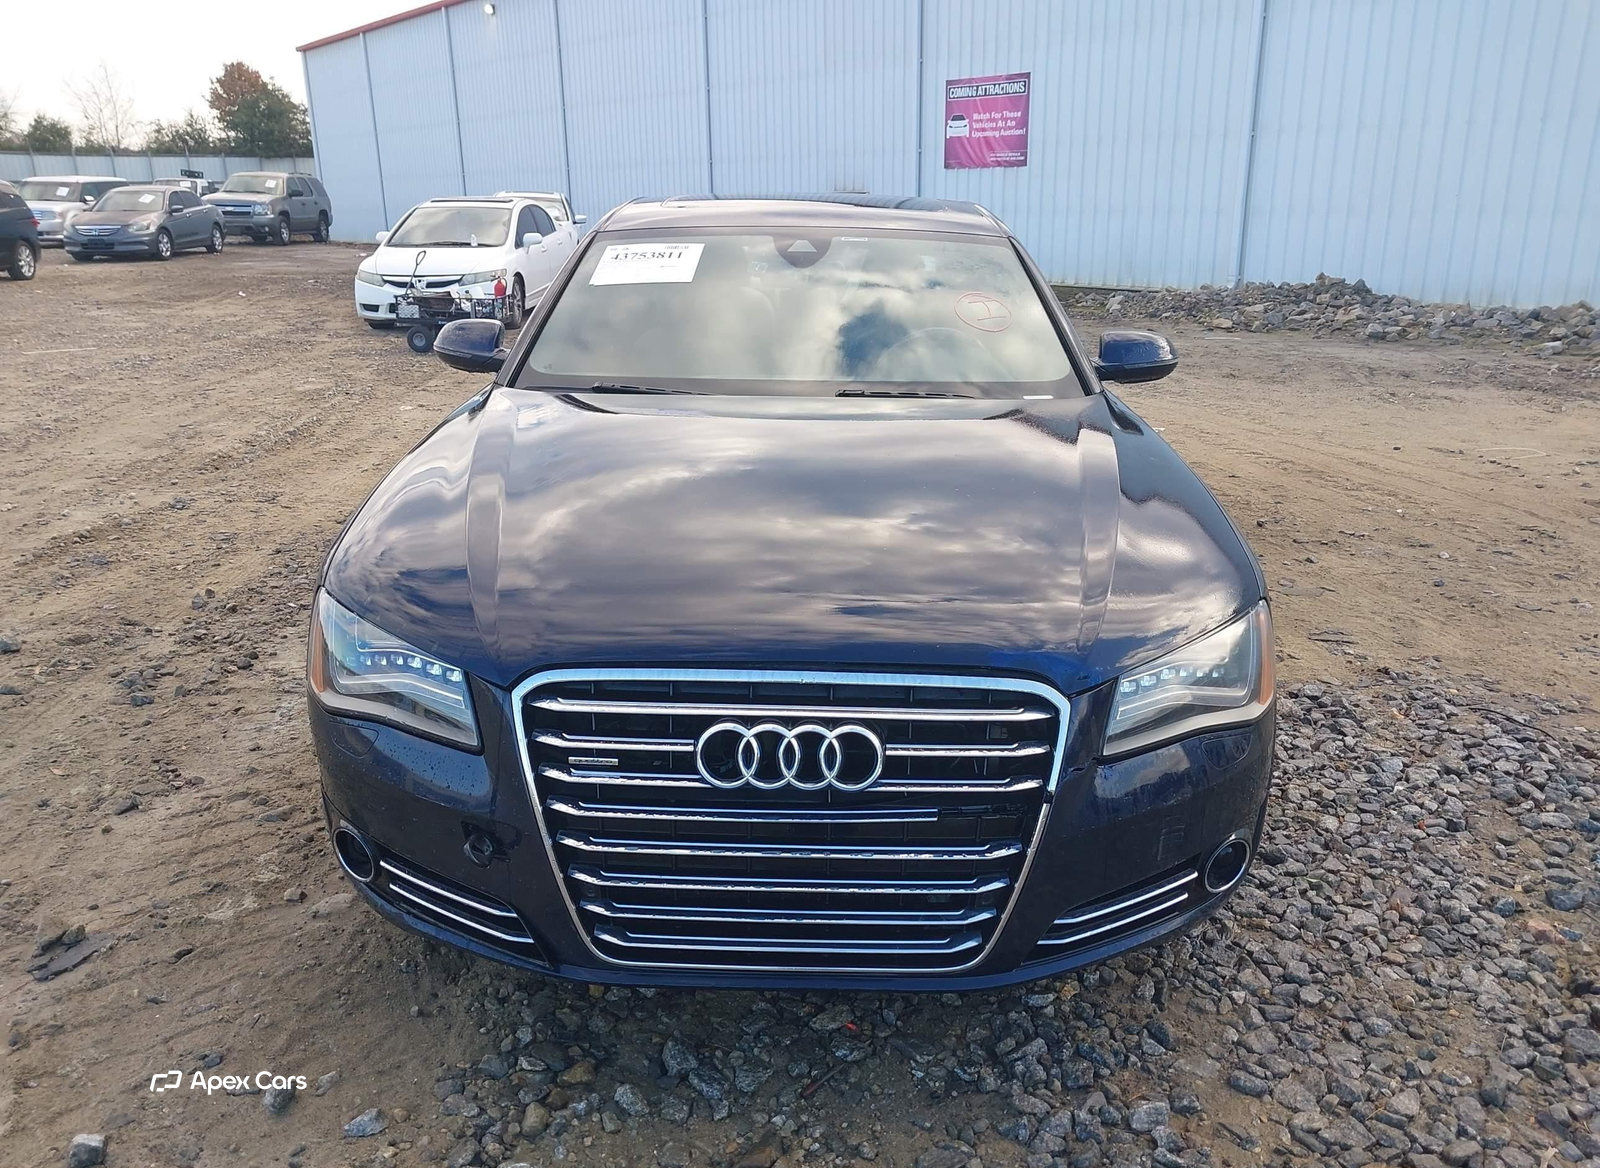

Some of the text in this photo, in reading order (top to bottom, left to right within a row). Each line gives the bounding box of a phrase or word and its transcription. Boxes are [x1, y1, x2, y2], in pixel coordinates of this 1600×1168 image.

[949, 81, 1025, 98] COMING ATTRACTIONS
[972, 110, 1022, 120] Watch For These
[972, 120, 996, 128] Vehicles
[1006, 119, 1016, 127] An
[971, 127, 1026, 138] Upcoming Auction!
[610, 251, 683, 260] 43753811
